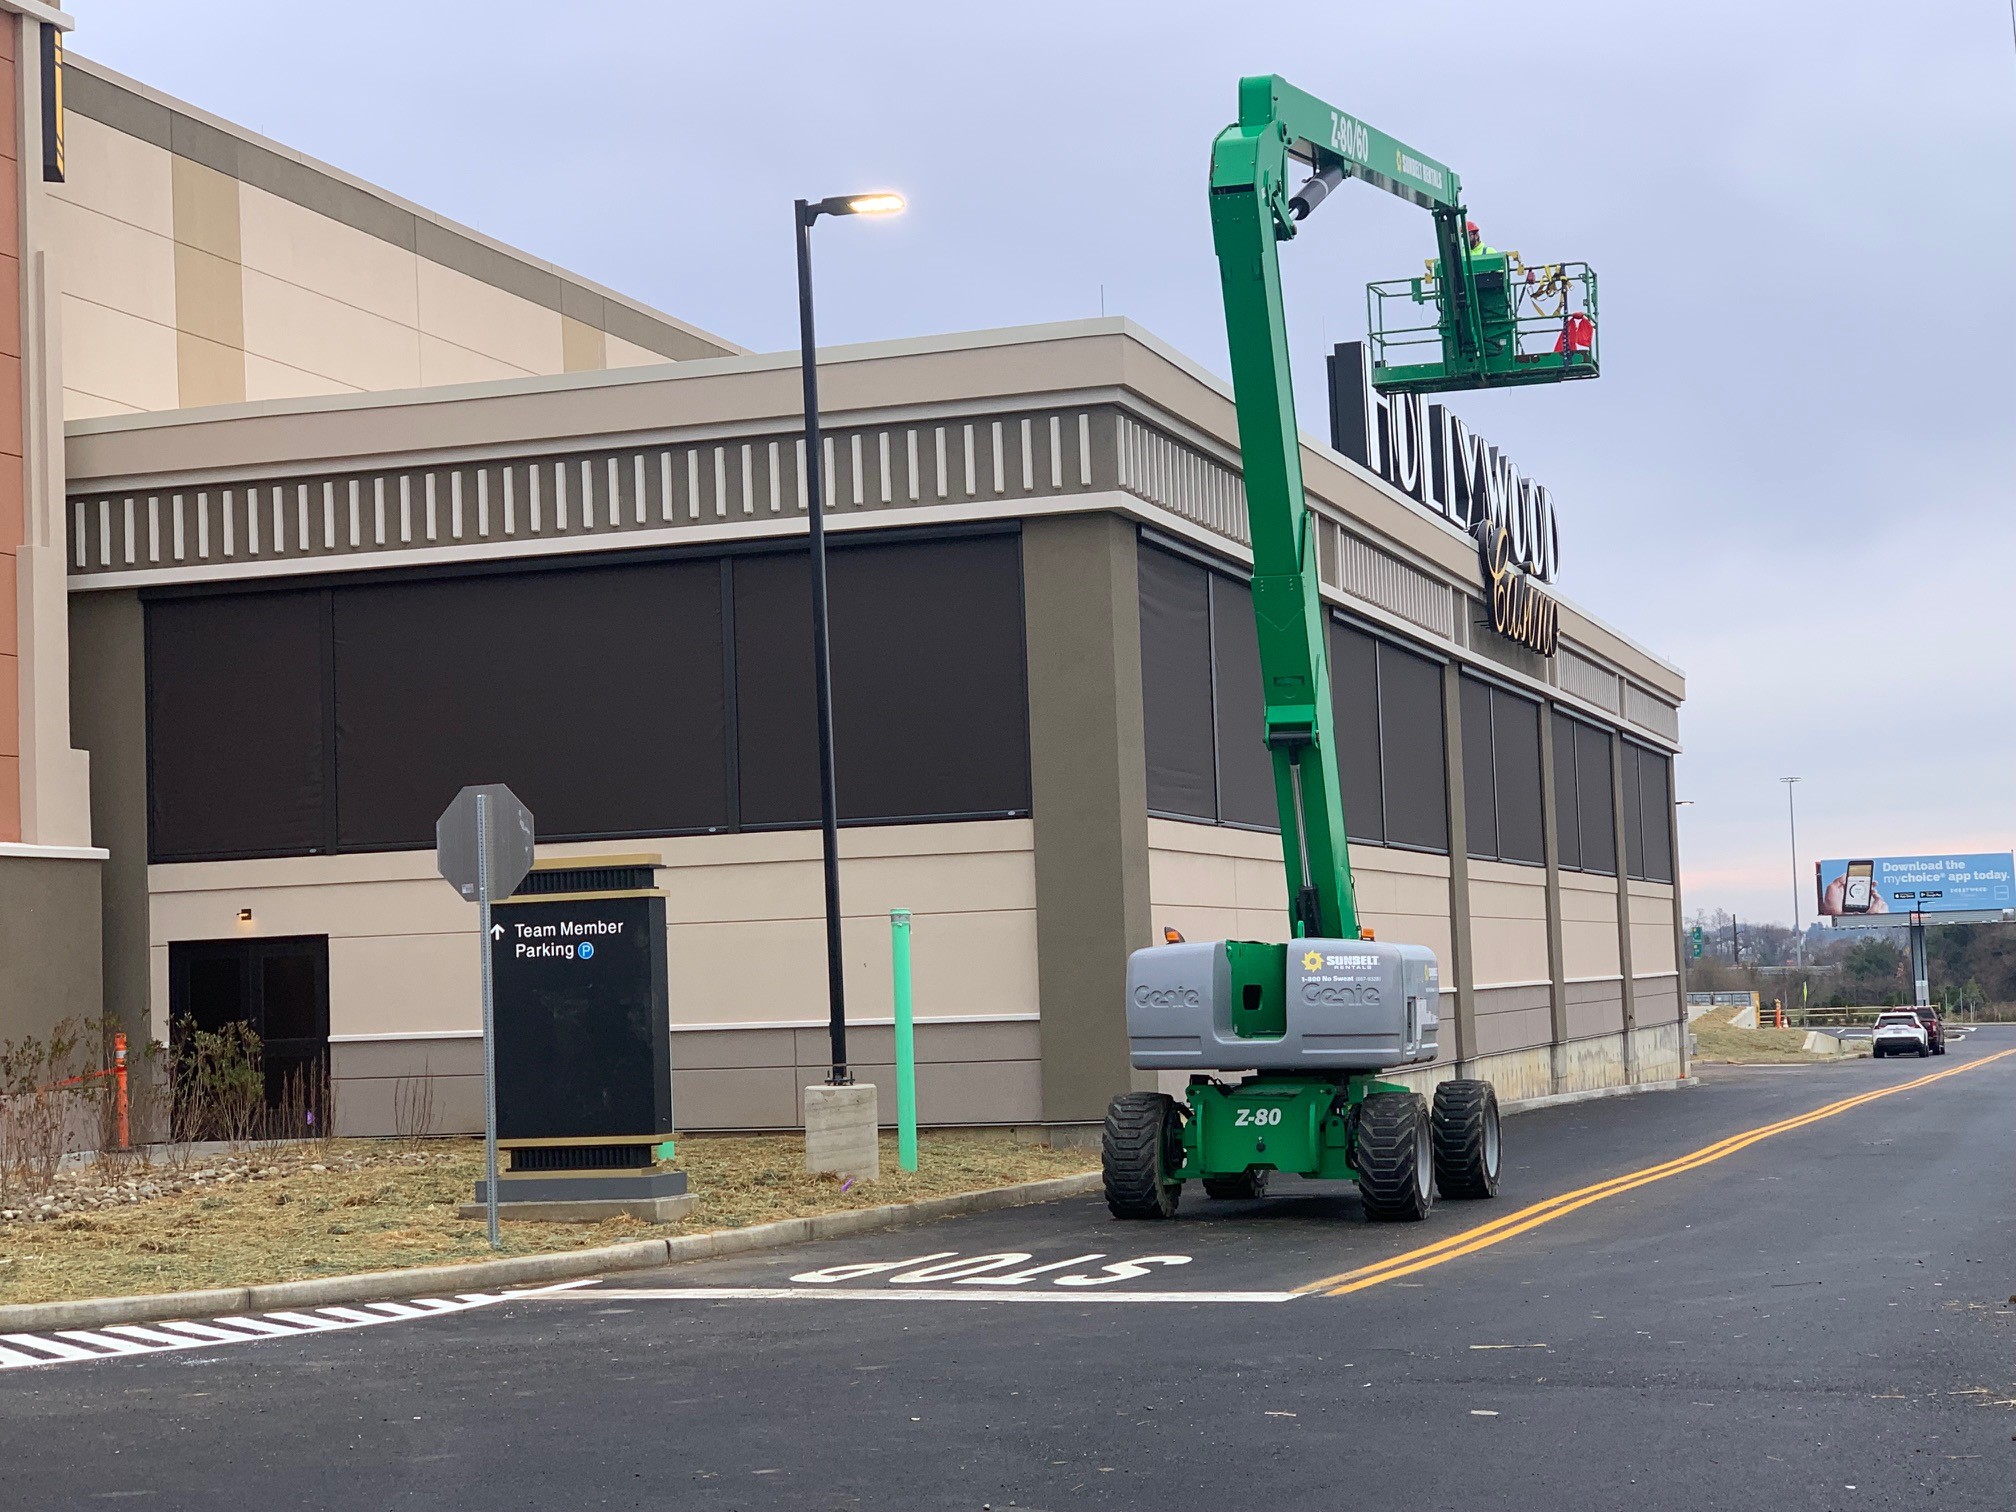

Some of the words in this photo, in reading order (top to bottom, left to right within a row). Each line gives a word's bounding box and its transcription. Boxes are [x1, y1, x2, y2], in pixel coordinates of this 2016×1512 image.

[1330, 111, 1369, 163] Z-80/60
[1882, 861, 1944, 872] Download
[1945, 860, 1966, 870] the
[1948, 871, 1971, 883] app
[1973, 870, 2010, 882] today.
[514, 923, 556, 938] Team
[560, 920, 624, 936] Member
[515, 942, 574, 959] Parking
[1326, 955, 1379, 966] SUNBELT
[1134, 984, 1199, 1008] Genie
[1301, 982, 1380, 1006] Genie
[1234, 1107, 1282, 1126] Z-80
[789, 1252, 1193, 1286] STOP
